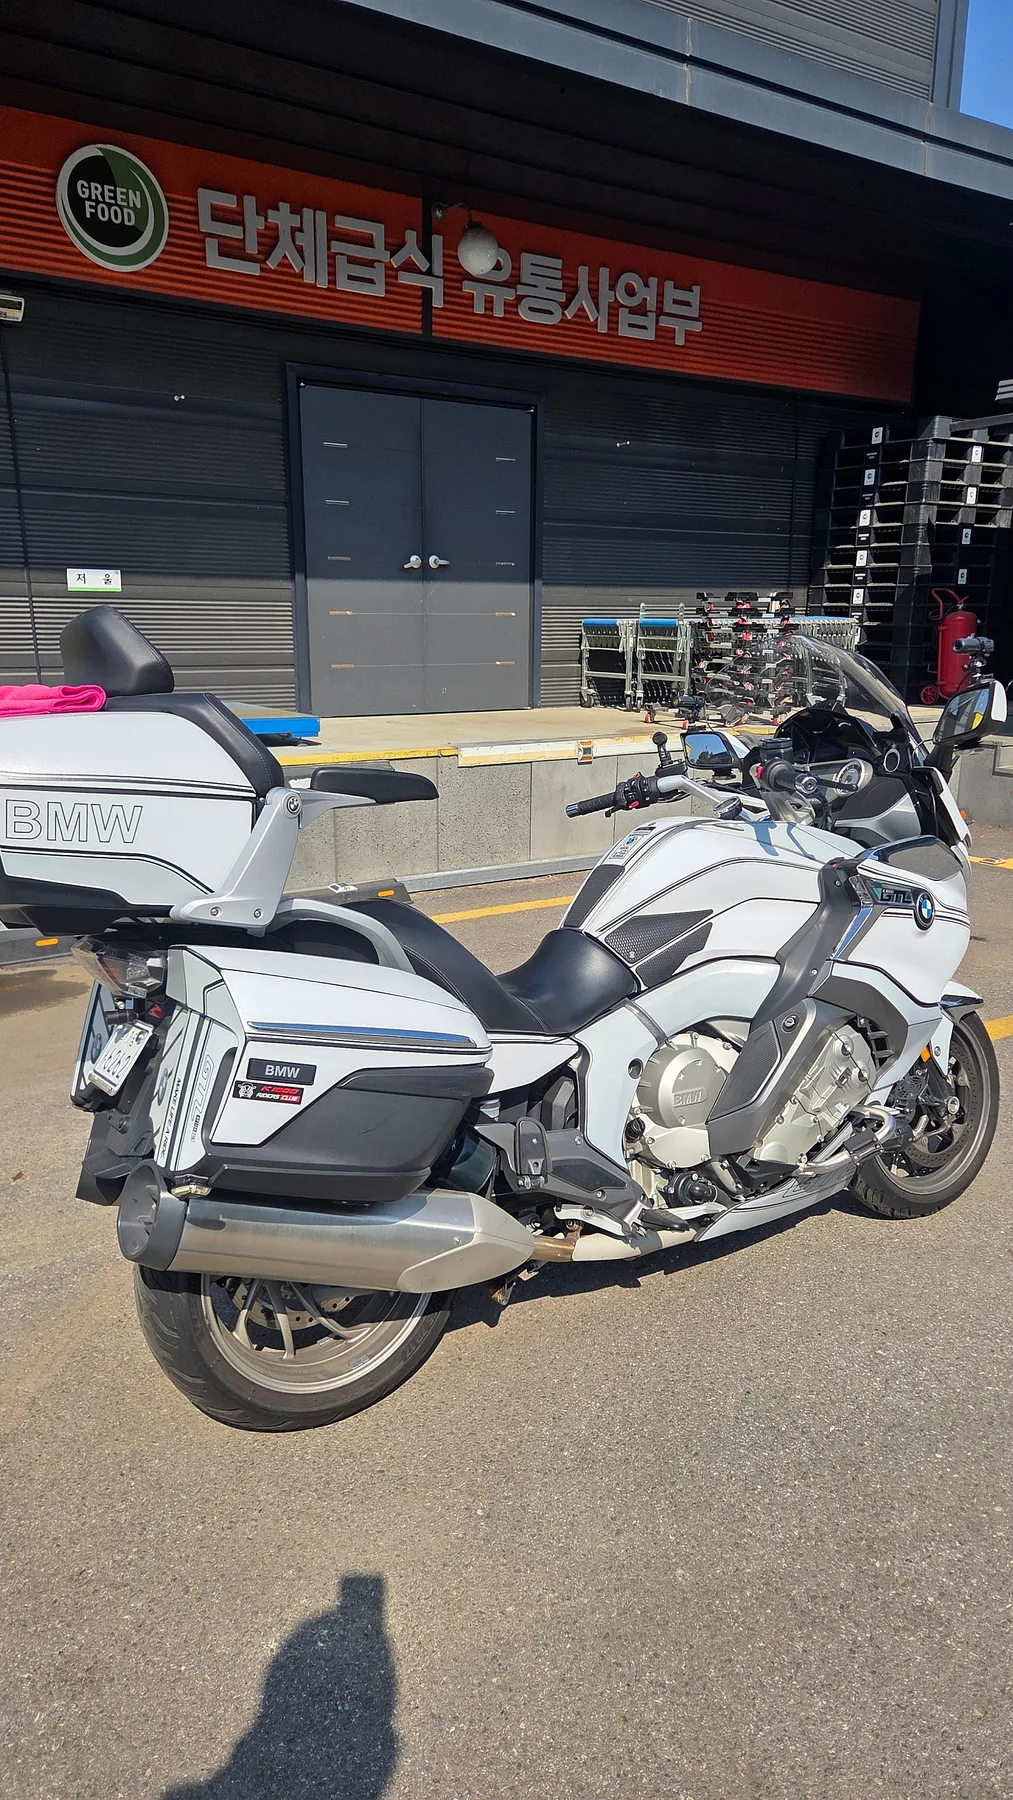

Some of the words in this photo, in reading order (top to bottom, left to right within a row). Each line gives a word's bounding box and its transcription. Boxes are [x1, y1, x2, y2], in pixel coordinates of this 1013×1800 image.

[77, 179, 142, 209] GREEN
[85, 200, 136, 227] FOOD
[197, 187, 445, 308] 단체급식
[462, 247, 703, 346] 유통사업부
[5, 799, 144, 844] BMW
[264, 1064, 301, 1079] BMW
[172, 1077, 182, 1105] MAKE
[673, 1090, 703, 1107] BMW
